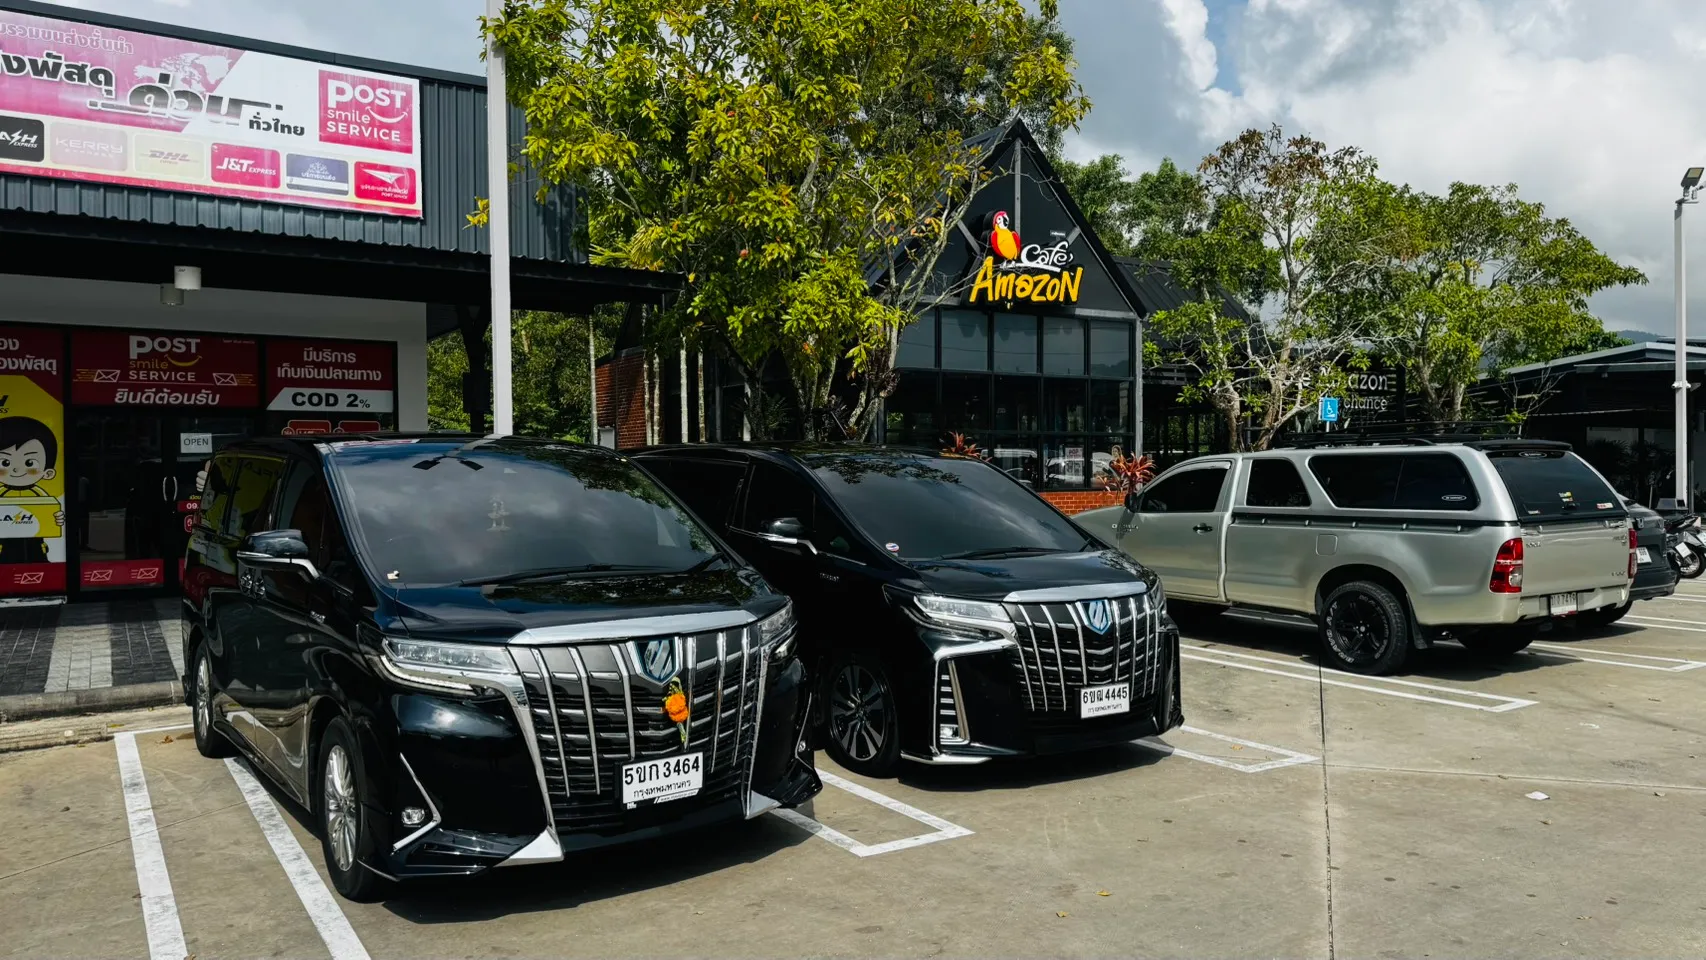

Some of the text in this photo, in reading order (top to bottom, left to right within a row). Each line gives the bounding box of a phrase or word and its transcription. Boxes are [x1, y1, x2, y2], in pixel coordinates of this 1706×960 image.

[327, 79, 406, 109] POST
[248, 112, 306, 136] ทั่วไทย
[327, 109, 371, 124] smile
[327, 121, 401, 143] SERVICE
[55, 137, 123, 154] KERRY
[148, 150, 191, 162] DHL
[216, 157, 277, 176] J&T EXPRESS
[128, 335, 201, 360] POST
[303, 346, 357, 363] มีบริการ
[129, 359, 169, 370] smile
[277, 362, 382, 381] เก็บเงินปลายทาง
[128, 370, 197, 382] SERVICE
[114, 388, 220, 406] ยินดีต้อนรับ
[291, 392, 371, 409] COD 2%
[1343, 394, 1388, 410] chance
[183, 438, 209, 446] OPEN
[1105, 686, 1128, 702] 4445
[624, 756, 700, 785] 5ขก 3464
[633, 779, 692, 799] กรุงเทพมหานคร
